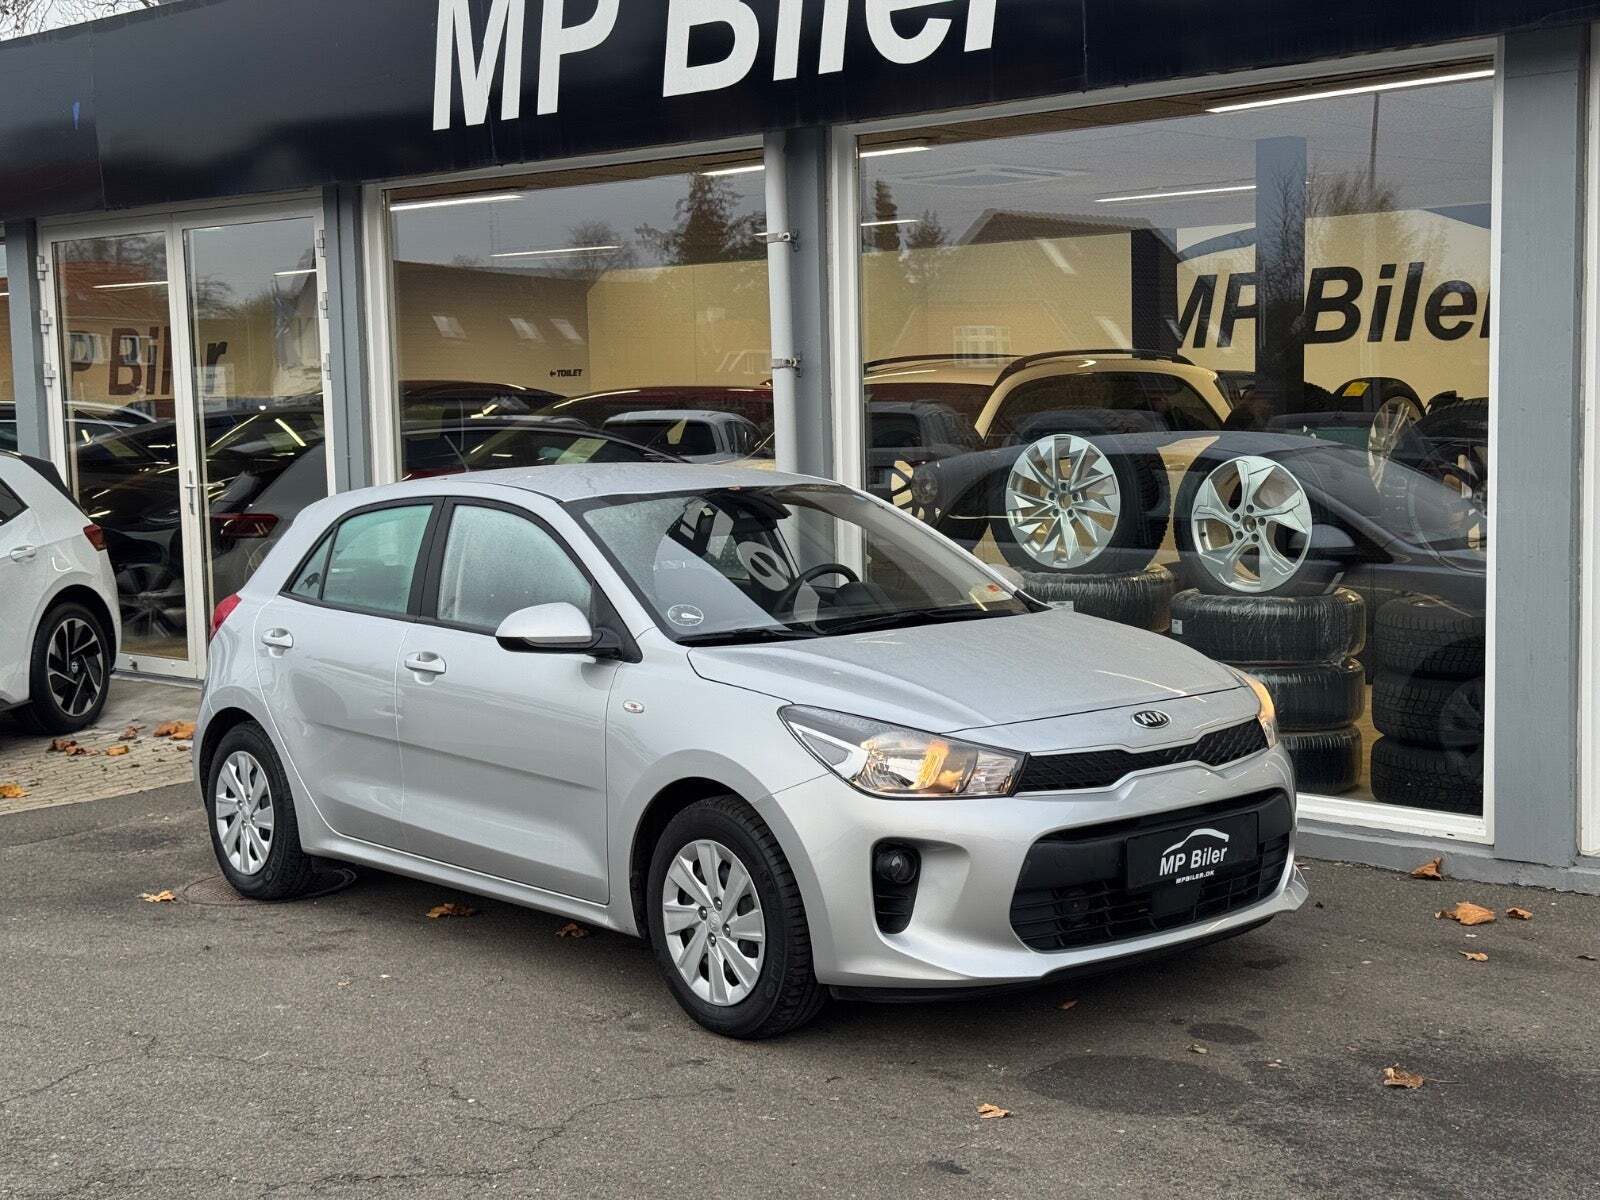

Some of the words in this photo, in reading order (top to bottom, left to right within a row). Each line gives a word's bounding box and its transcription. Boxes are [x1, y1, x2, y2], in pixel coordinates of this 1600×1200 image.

[433, 0, 617, 131] MP
[1304, 261, 1490, 345] Bile
[109, 326, 228, 396] Bilr
[557, 368, 583, 377] TOILET
[1136, 711, 1168, 725] KIA
[1159, 853, 1186, 876] MP
[1190, 846, 1228, 869] Biler
[1175, 869, 1215, 885] MPBILER.DK
